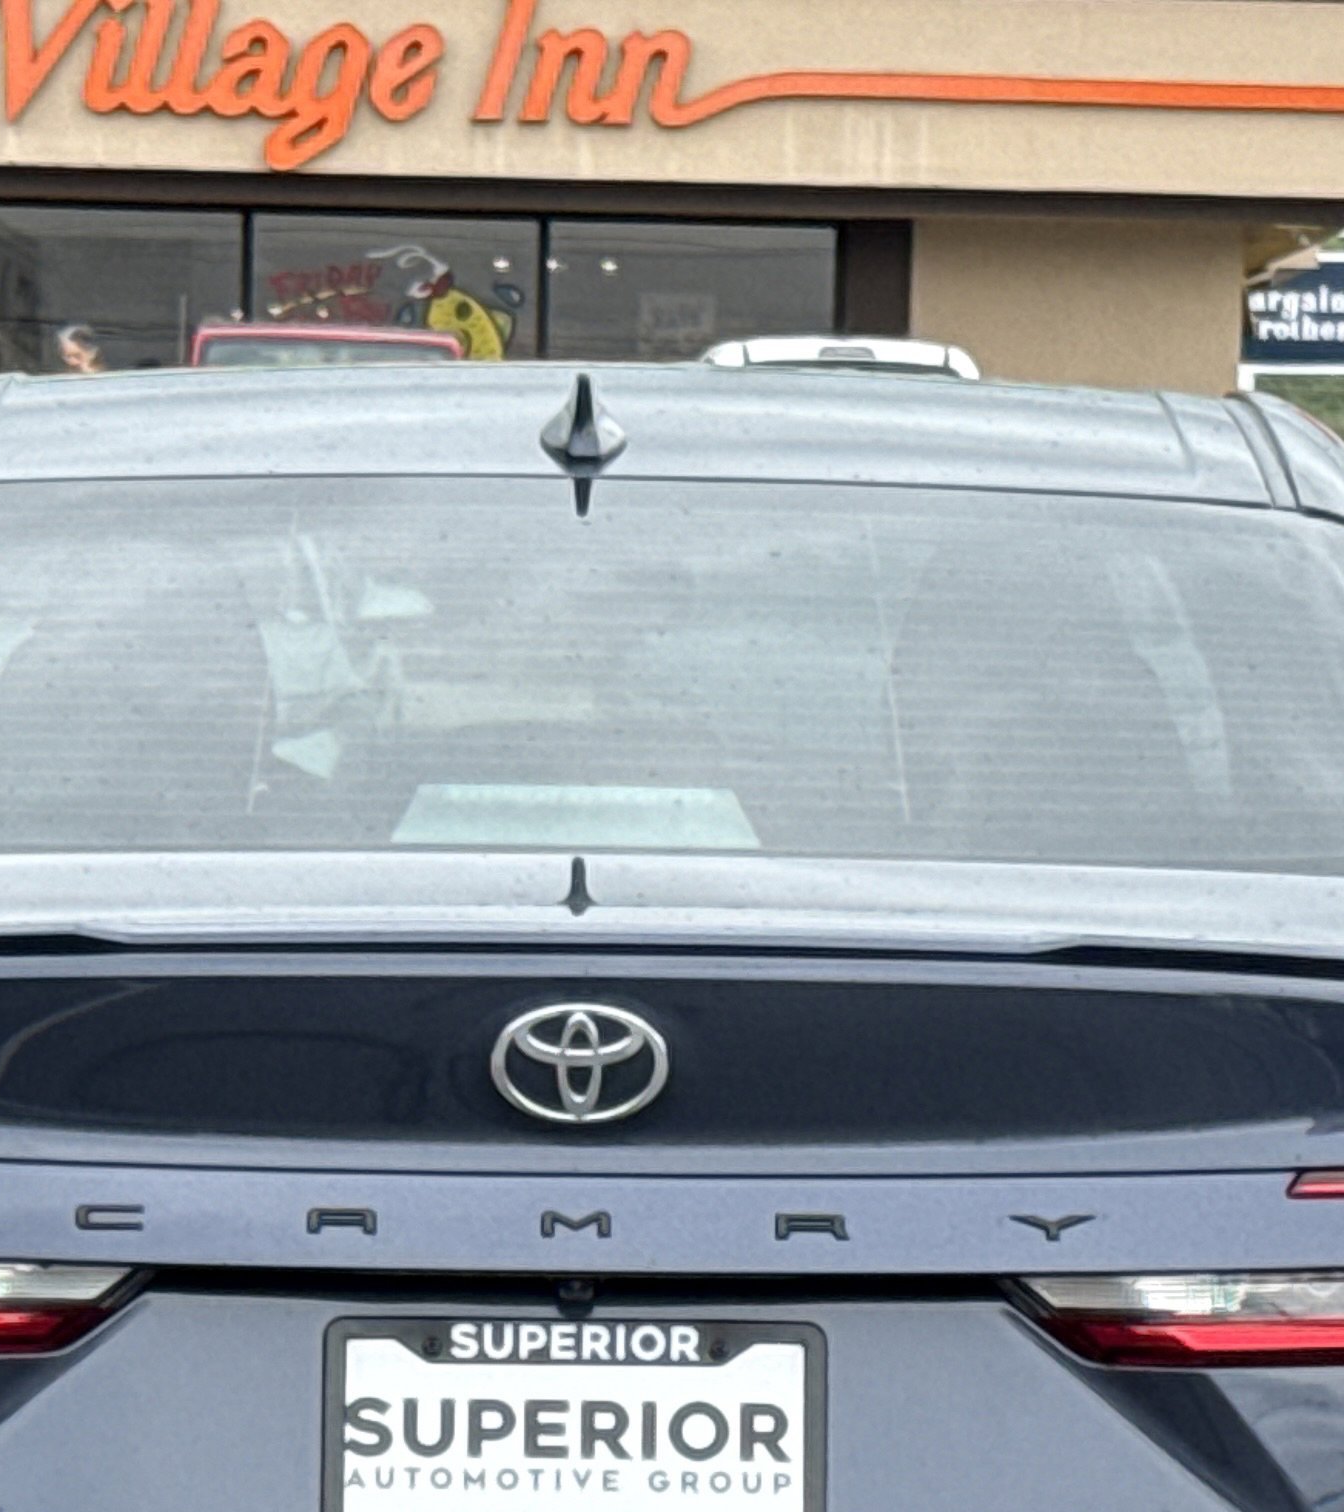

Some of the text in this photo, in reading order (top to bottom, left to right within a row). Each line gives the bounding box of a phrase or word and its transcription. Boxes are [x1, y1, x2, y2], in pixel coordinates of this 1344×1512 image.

[2, 0, 706, 171] Village Inn
[74, 1203, 1096, 1242] CAMRY
[450, 1323, 700, 1361] SUPERIOR
[344, 1397, 792, 1462] SUPERIOR
[347, 1467, 792, 1495] AUTOMOTIVE GROUP
